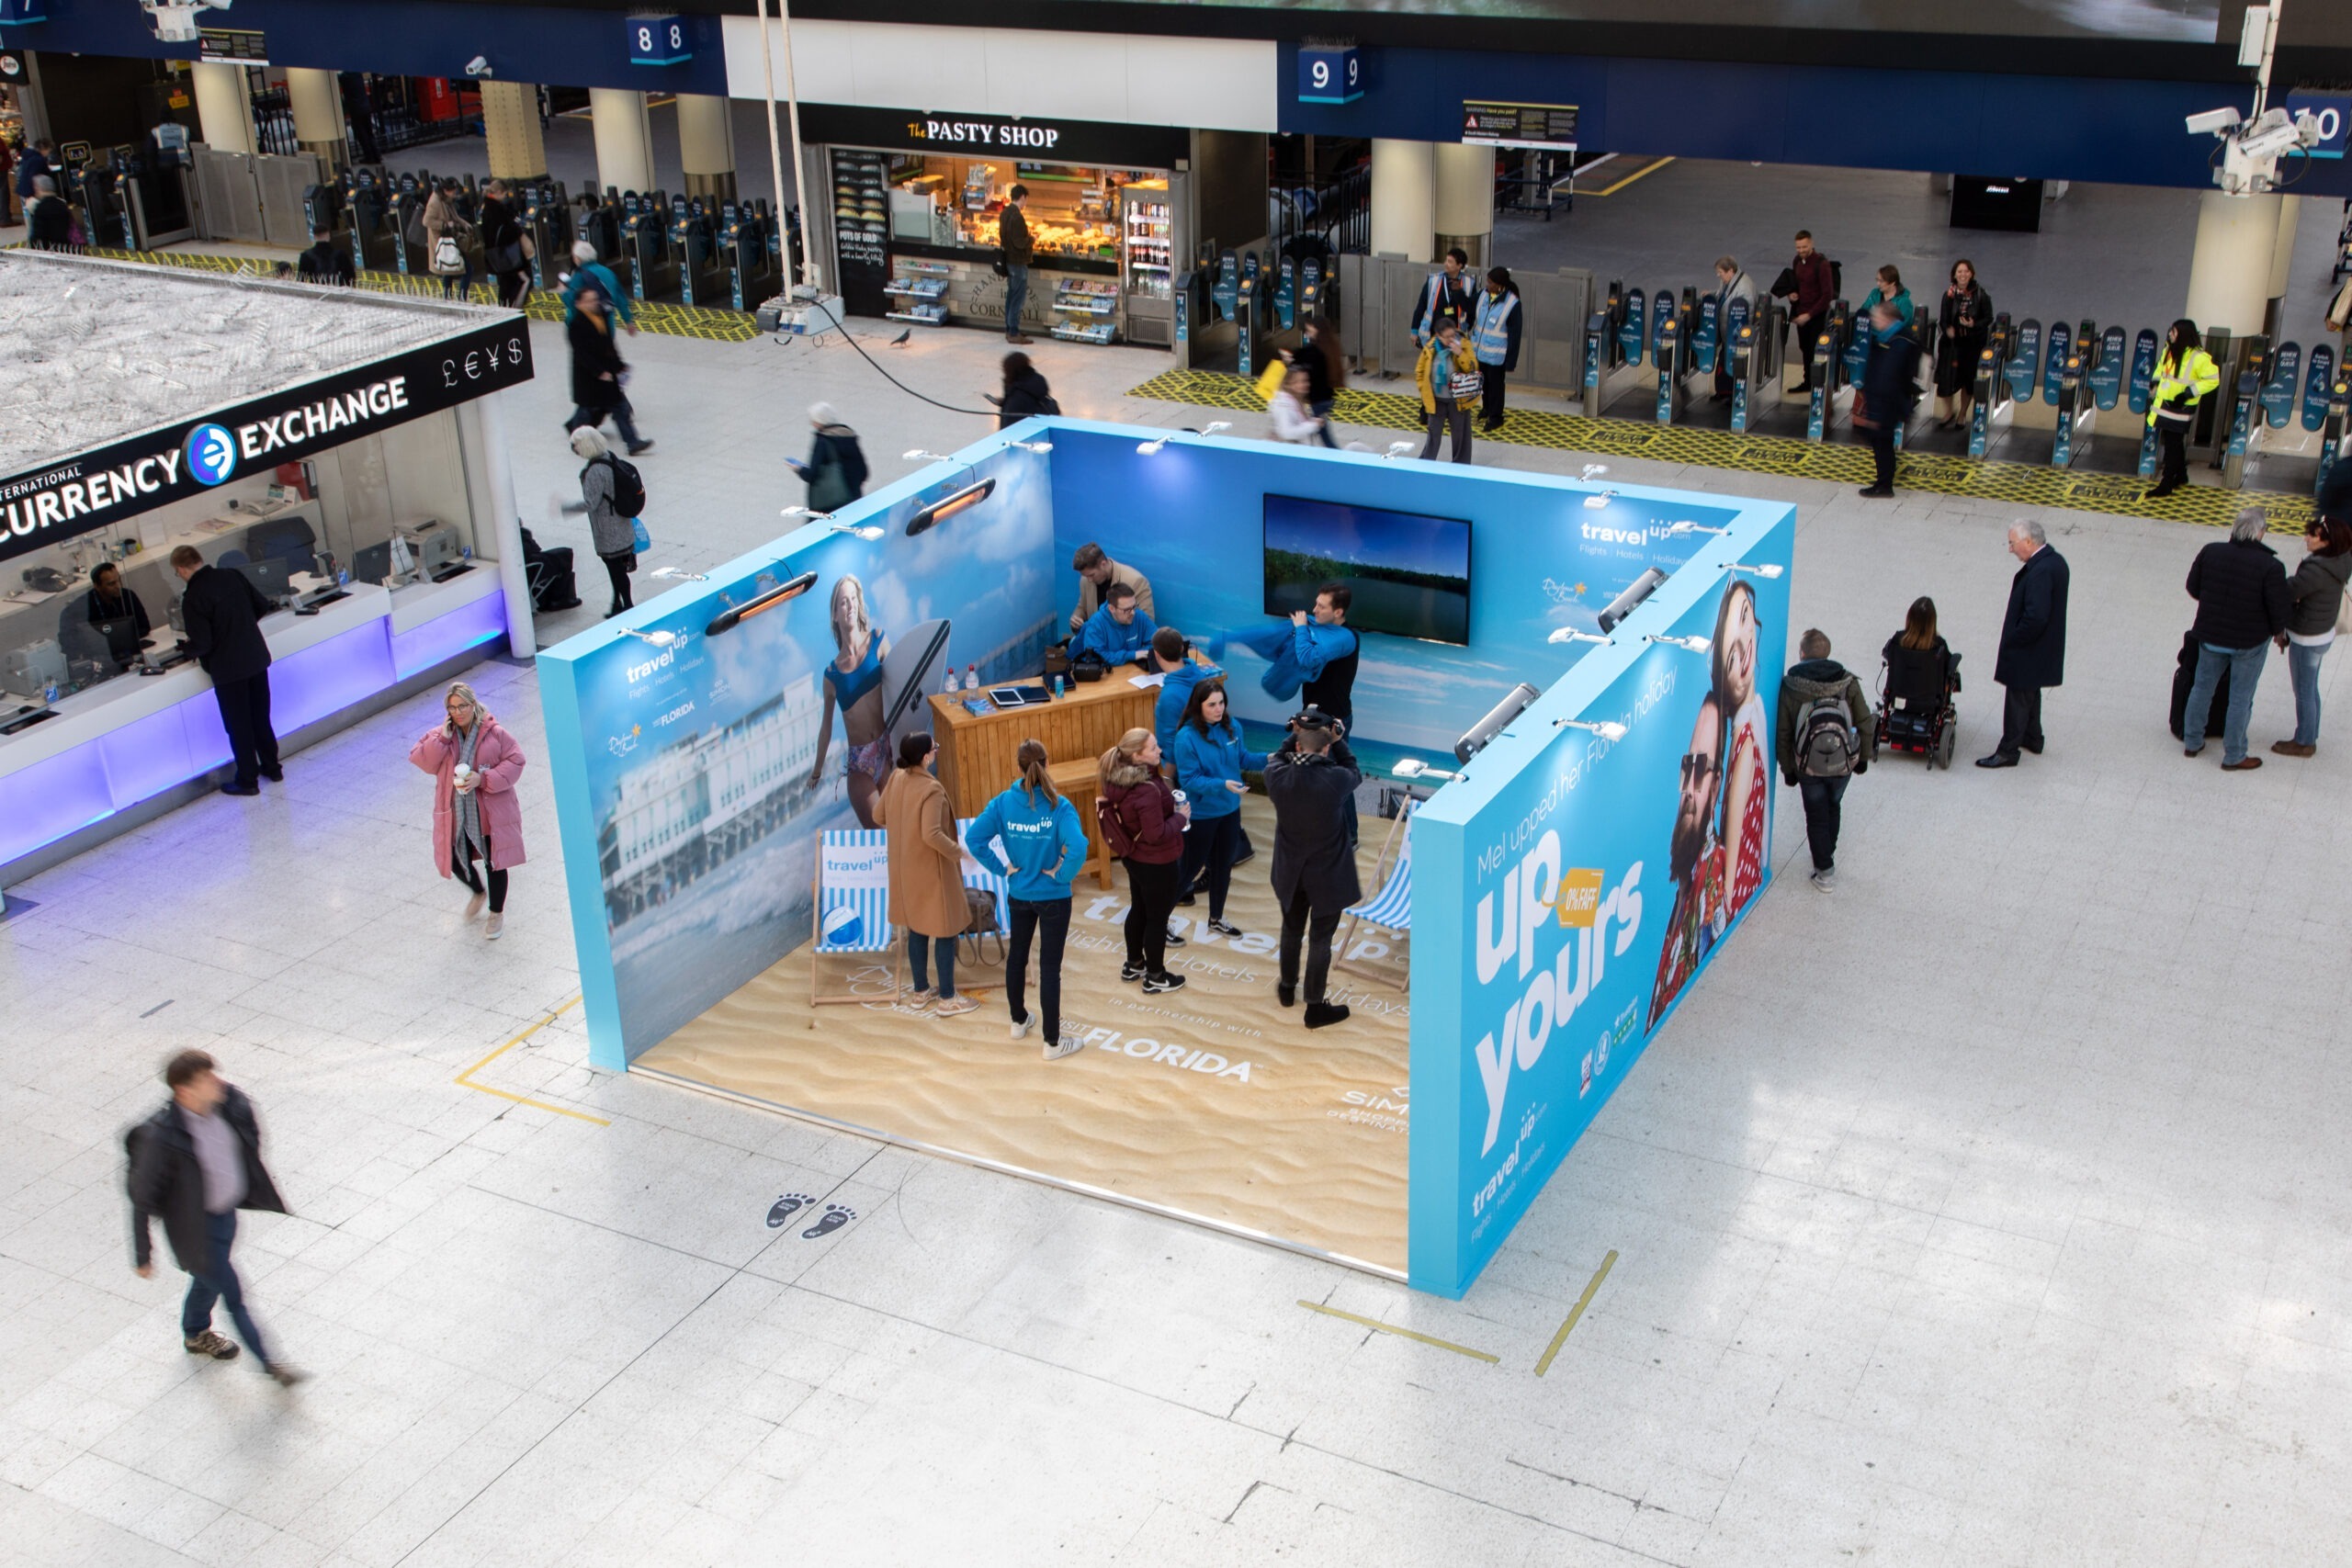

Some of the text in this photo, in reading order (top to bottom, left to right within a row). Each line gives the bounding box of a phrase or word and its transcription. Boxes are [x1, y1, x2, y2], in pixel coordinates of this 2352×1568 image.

[639, 27, 652, 51] 8
[670, 25, 681, 50] 8
[1312, 61, 1329, 89] 9
[1349, 58, 1358, 86] 9
[908, 120, 1059, 148] The PASTY SHOP
[839, 231, 877, 243] POTS OF GOLD
[969, 303, 1042, 321] CORNALL
[238, 376, 408, 460] EXCHANGE
[1581, 522, 1647, 547] travel
[1579, 544, 1686, 566] Flights Hotels Holiday
[627, 646, 674, 684] travel
[628, 684, 650, 700] Flights
[655, 671, 674, 686] Hotels
[680, 656, 705, 674] Holidays
[661, 701, 695, 727] FLORIDA
[1477, 665, 1678, 885] Mel upped her Flora holiday
[1007, 820, 1040, 833] travel
[827, 859, 873, 872] travel
[1476, 829, 1562, 986] up
[1578, 886, 1598, 911] FAFF
[1066, 927, 1127, 955] light
[1166, 952, 1259, 984] Hotels
[1108, 997, 1262, 1037] in partnership with
[1475, 860, 1644, 1159] yours
[1083, 1027, 1252, 1083] FLORIDA
[1340, 1090, 1409, 1115] SIM
[1326, 1110, 1409, 1135] DESTINAT
[1348, 1108, 1409, 1127] SHOPP
[1472, 1140, 1520, 1218] travel
[1471, 1142, 1545, 1245] Flights Hotels Holidays
